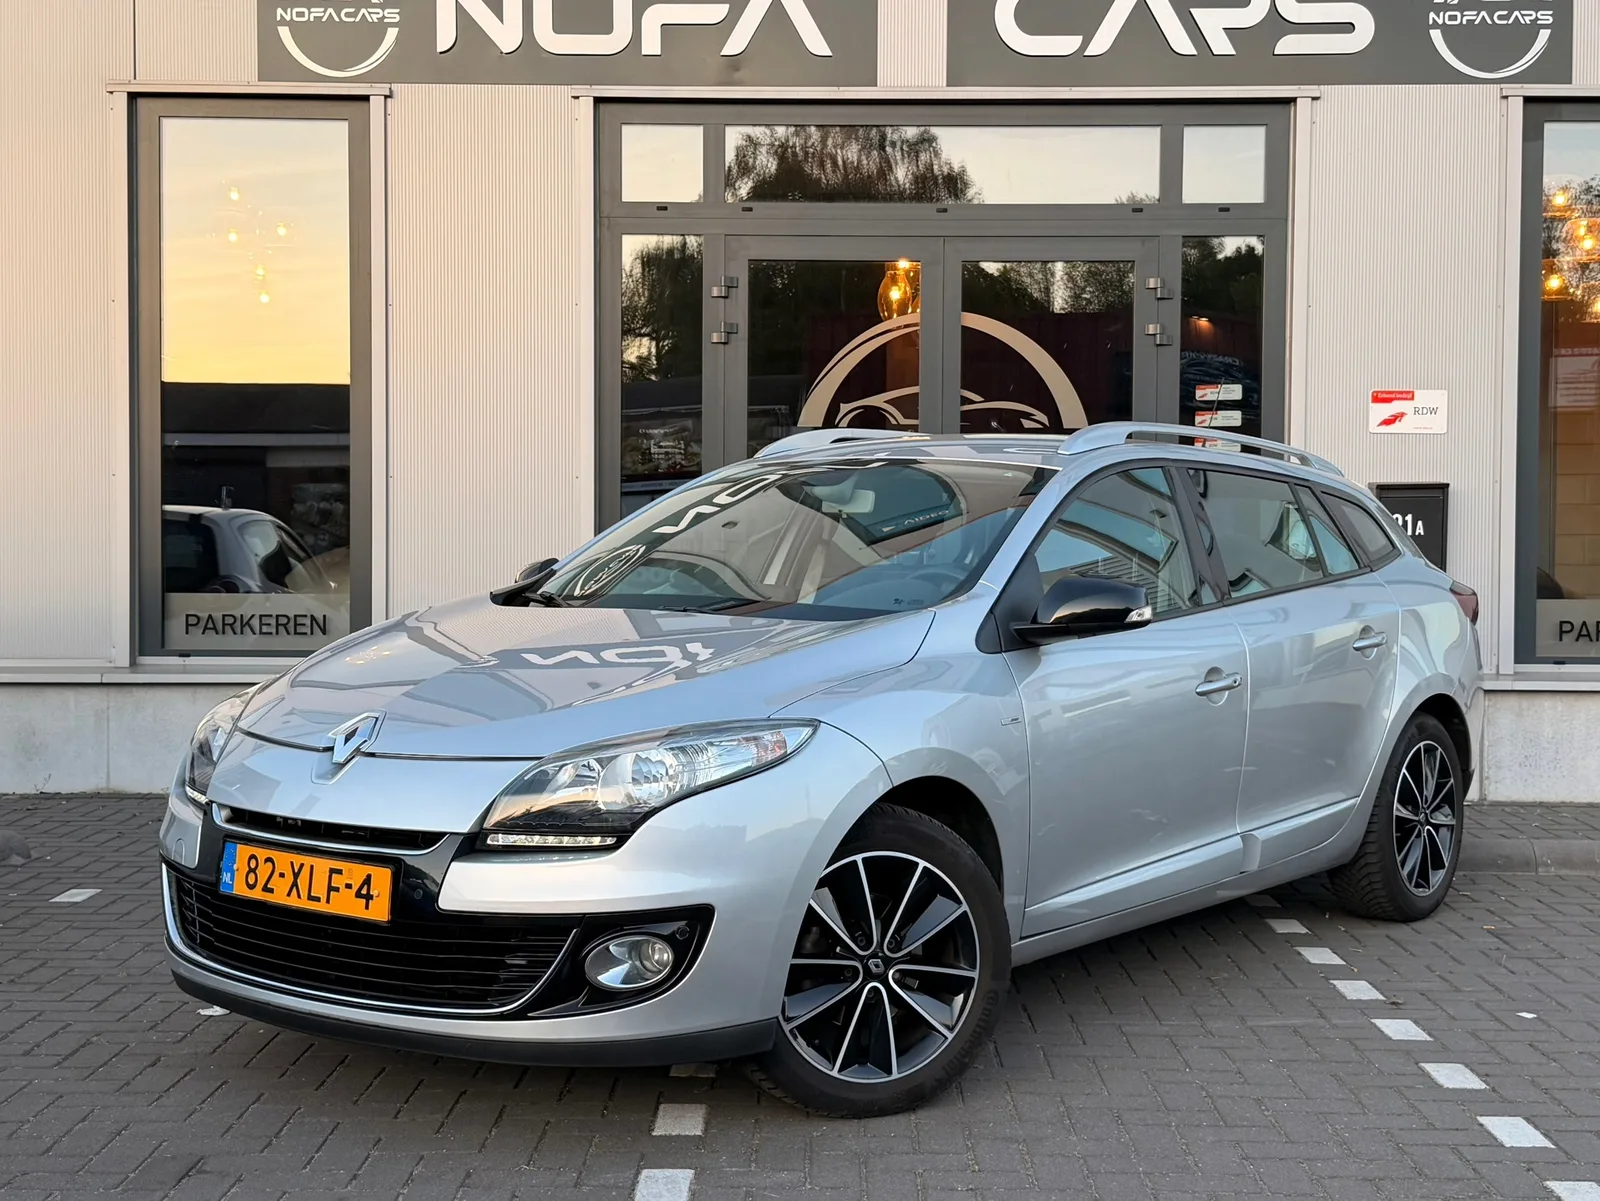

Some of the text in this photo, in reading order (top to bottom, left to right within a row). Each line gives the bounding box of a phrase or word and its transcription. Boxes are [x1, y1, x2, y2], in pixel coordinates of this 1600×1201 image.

[1413, 406, 1439, 416] RDW
[185, 613, 327, 636] PARKEREN
[1558, 620, 1600, 643] PA
[222, 871, 234, 885] NL
[244, 853, 375, 911] 82-XLF-4
